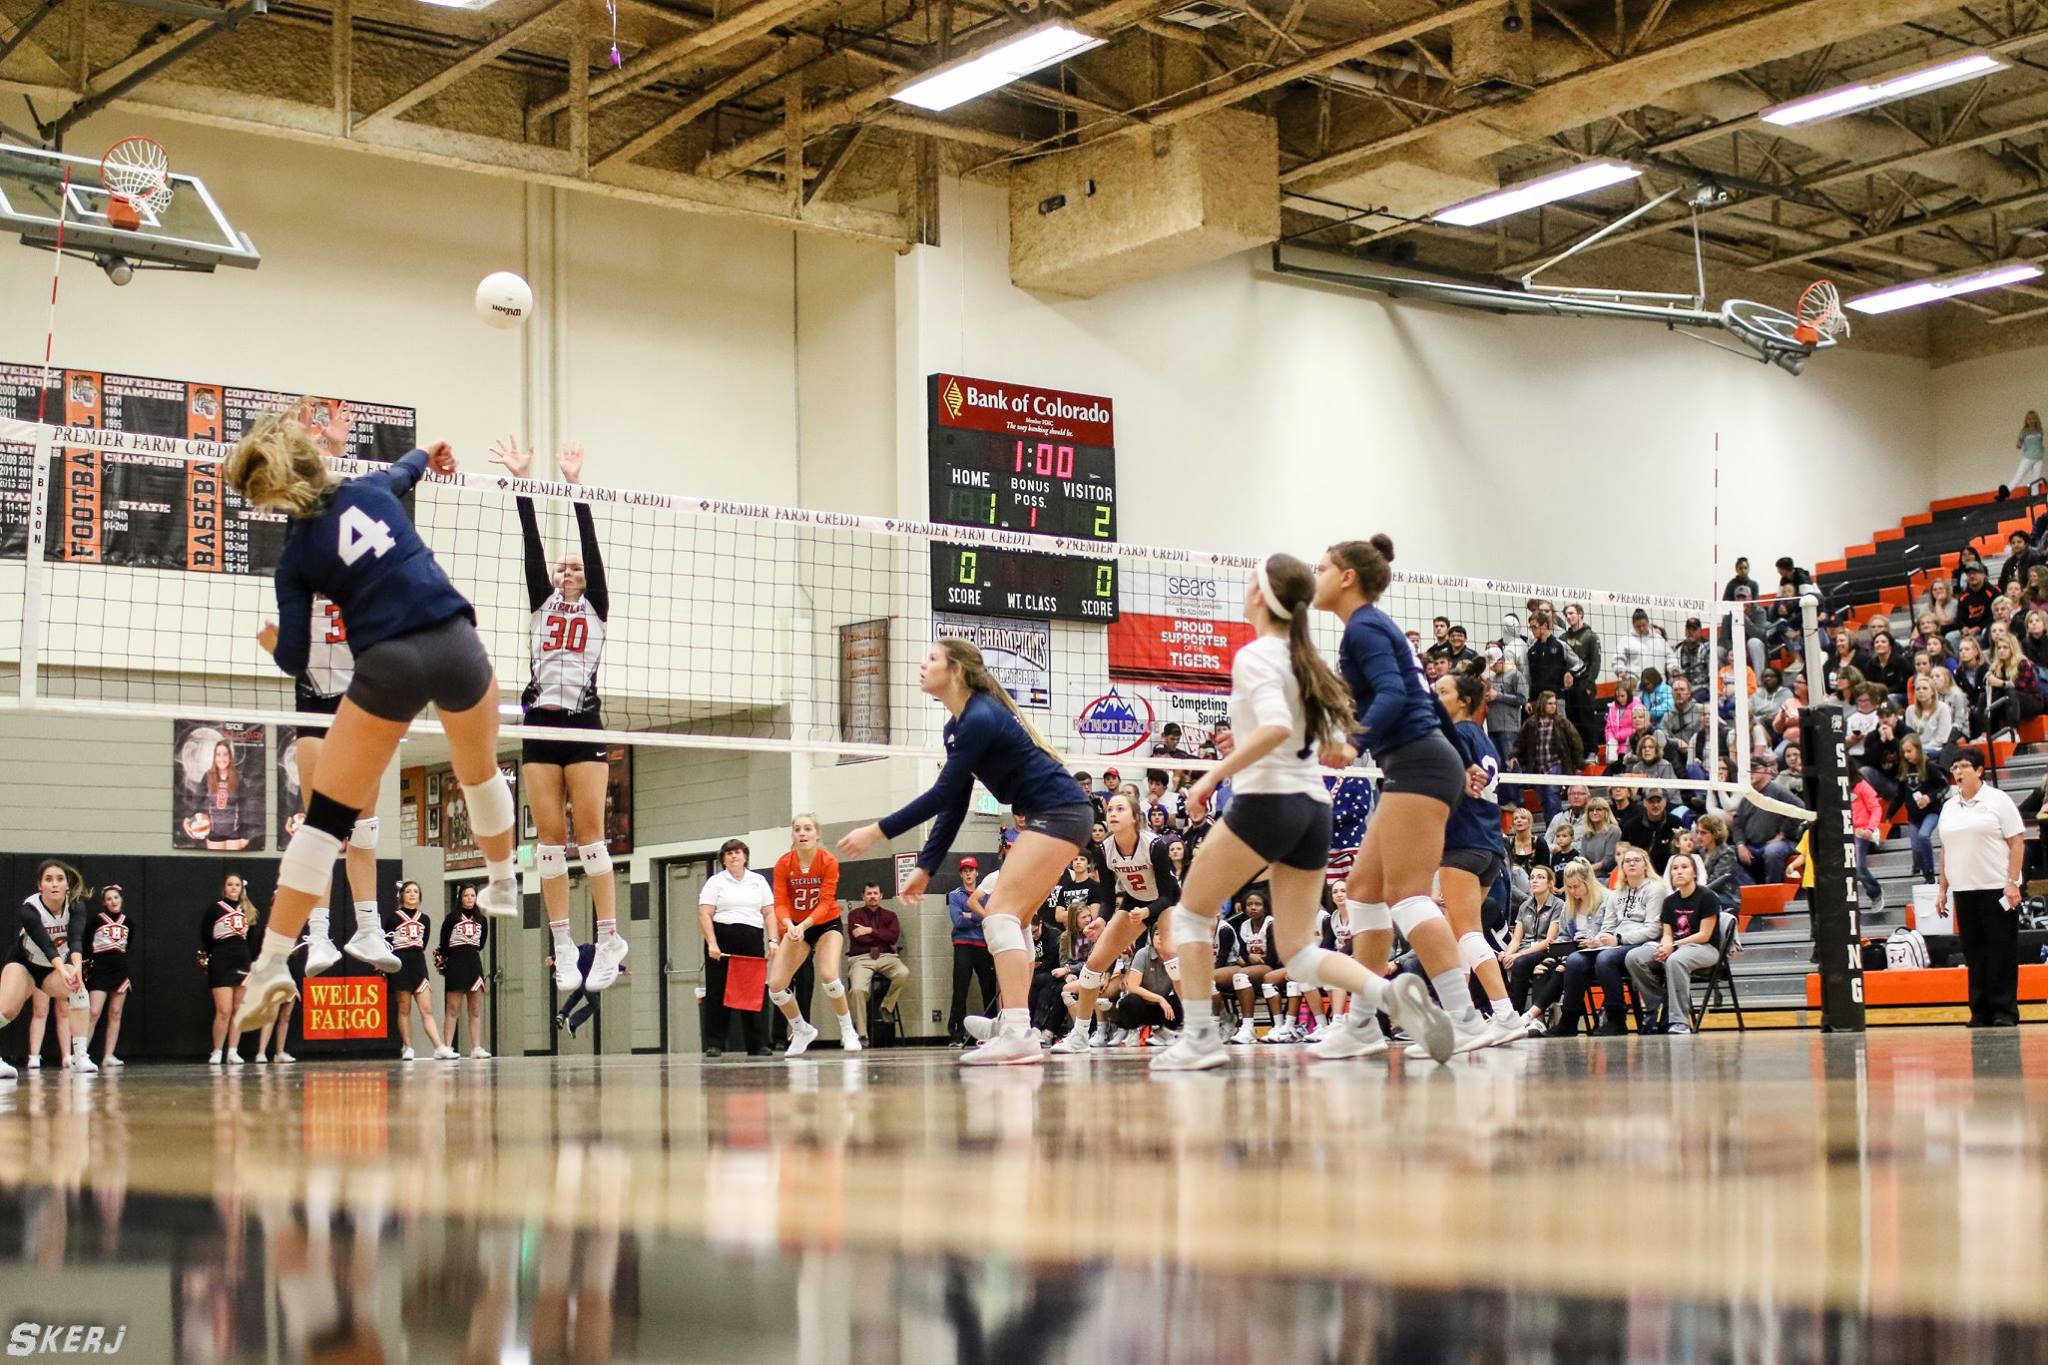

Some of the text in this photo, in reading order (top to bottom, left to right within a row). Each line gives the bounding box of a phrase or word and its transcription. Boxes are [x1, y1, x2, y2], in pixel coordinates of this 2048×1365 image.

[104, 375, 185, 391] CONFERENCE
[104, 384, 185, 401] CHAMPIONS
[966, 386, 1110, 424] Bank of Colorado
[1006, 421, 1017, 430] The
[1017, 424, 1028, 432] way
[1028, 424, 1049, 436] banking
[1049, 427, 1066, 436] should
[52, 427, 125, 448] PREMIER
[132, 435, 178, 454] FARM
[104, 453, 185, 468] CHAMPIONS
[1015, 440, 1074, 479] 1:00
[952, 468, 991, 488] HOME
[1011, 477, 1050, 493] BONUS
[512, 478, 672, 508] PREMIER FARM CREDIT
[1014, 493, 1047, 508] POSS.
[1063, 482, 1113, 502] VISITOR
[34, 477, 45, 544] BISON
[118, 500, 172, 513] STATE
[713, 502, 860, 527] PREMIER FARM CREDIT
[238, 511, 289, 523] STATE
[1094, 505, 1111, 538] 2
[337, 504, 396, 566] 4
[897, 521, 949, 537] PREMIER
[954, 528, 985, 541] FARM
[991, 532, 1033, 546] CREDIT
[1066, 538, 1113, 554] PREMIER
[1118, 546, 1148, 558] FARM
[1152, 549, 1191, 562] CREDIT
[959, 551, 977, 584] 0
[1096, 565, 1113, 598] 0
[1168, 577, 1217, 598] sears
[1408, 573, 1433, 585] FARM
[1437, 576, 1469, 588] CREDIT
[948, 587, 982, 606] SCORE
[1495, 582, 1592, 601] PREMIER FARM CREDIT
[1616, 593, 1651, 605] PREMIER
[1007, 593, 1057, 612] WT. CLASS
[1081, 600, 1113, 617] SCORE
[543, 615, 588, 653] 30
[1174, 620, 1214, 634] PROUD
[977, 626, 1047, 671] CHAMPIONS
[1161, 631, 1228, 648] SUPPORTER
[1169, 652, 1220, 669] TIGERS
[1172, 695, 1228, 715] Competing
[1073, 719, 1118, 732] PATRIOT
[1127, 873, 1147, 892] 2
[1835, 742, 1863, 1003] STERLING
[794, 888, 820, 910] 22
[310, 984, 379, 1006] WELLS
[311, 1007, 381, 1031] FARGO
